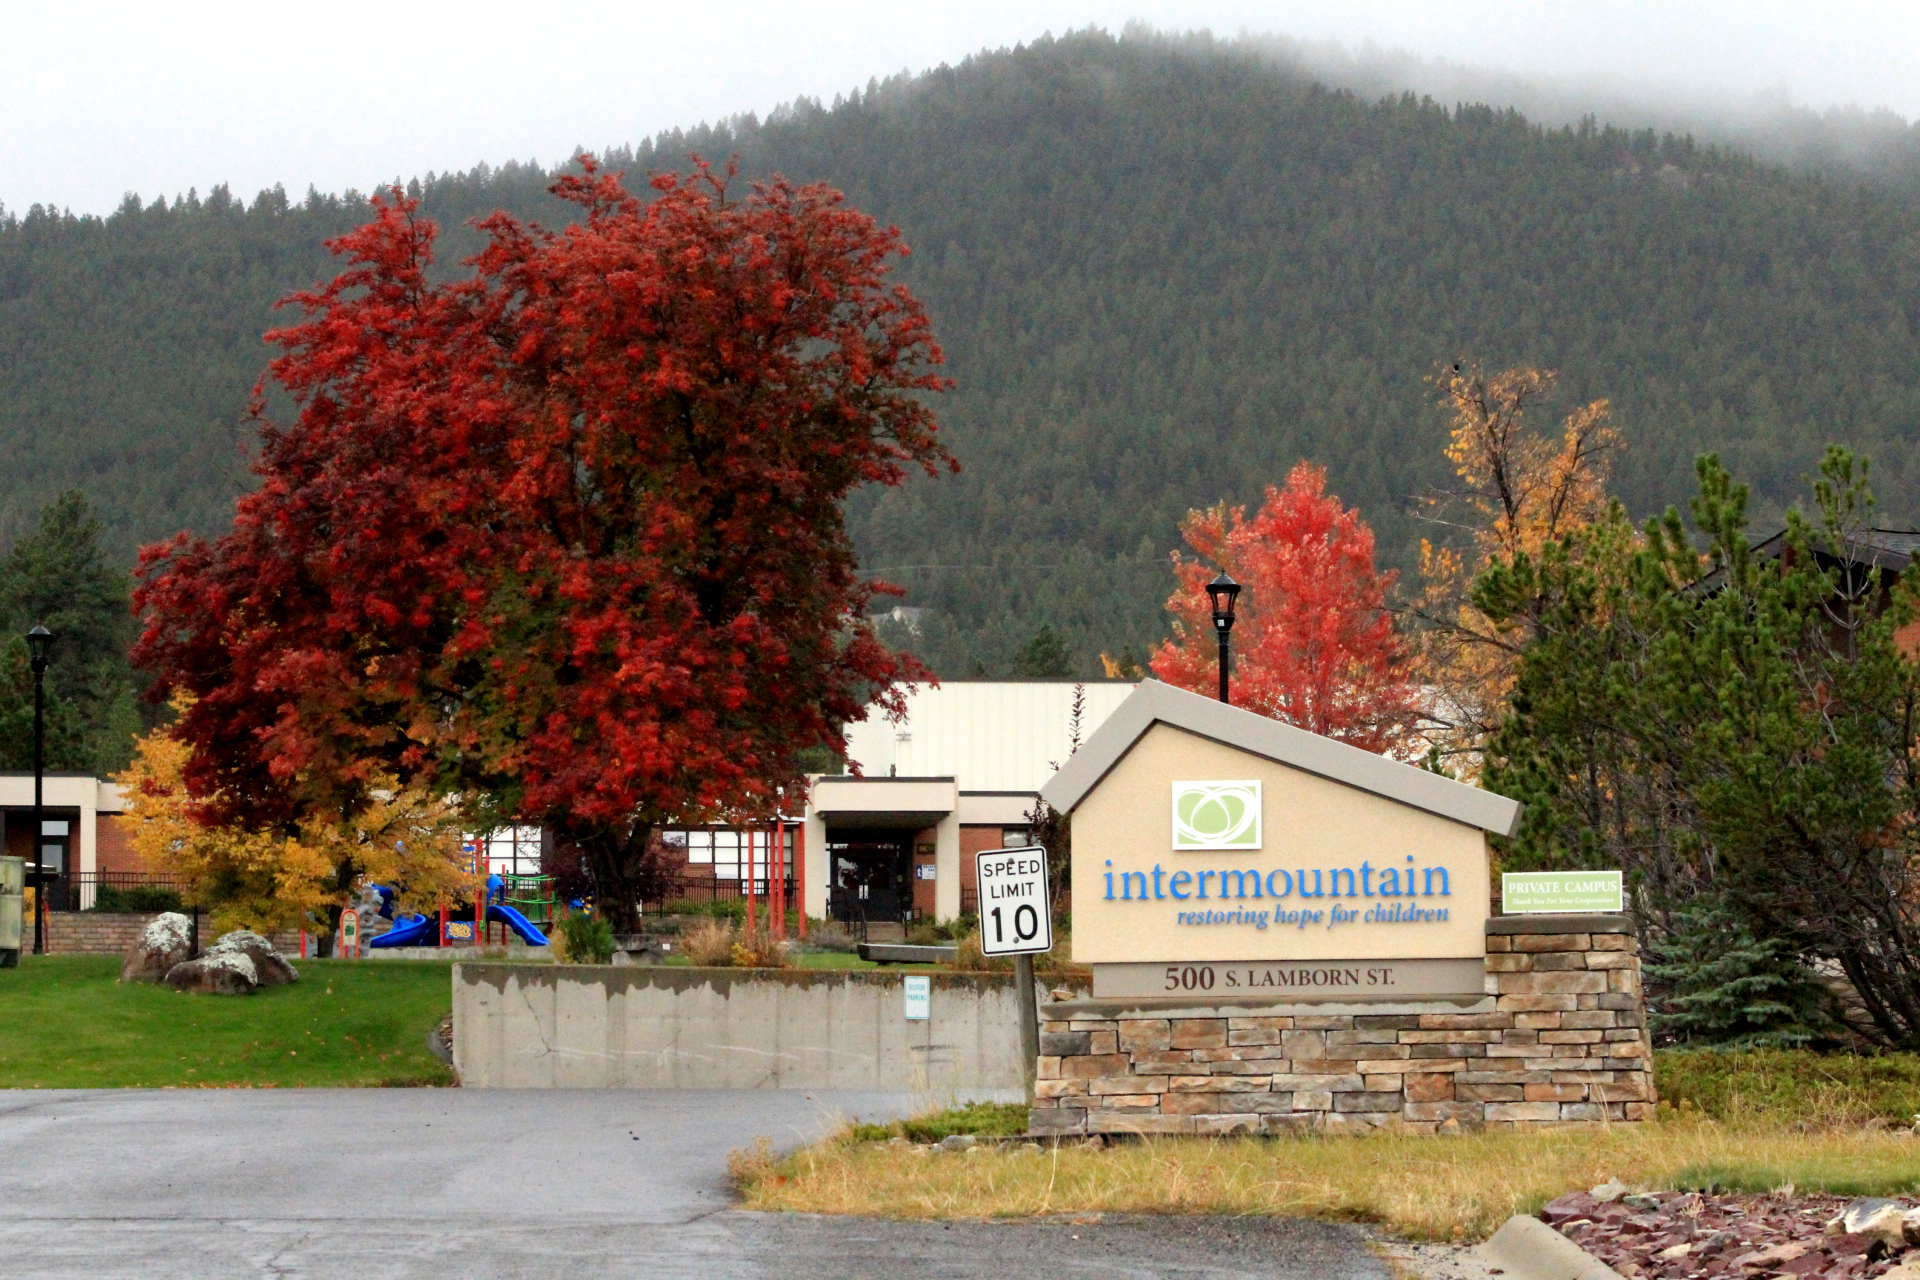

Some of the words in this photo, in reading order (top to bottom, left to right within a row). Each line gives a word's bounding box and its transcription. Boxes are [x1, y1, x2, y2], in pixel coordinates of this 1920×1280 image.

[983, 860, 1040, 877] SPEED
[1103, 855, 1451, 900] intermountain
[991, 882, 1034, 899] LIMIT
[1508, 881, 1560, 893] PRIVATE
[1565, 880, 1617, 893] CAMPUS
[991, 904, 1038, 942] 10
[1177, 905, 1268, 930] restoring
[1274, 904, 1323, 929] hope
[1328, 903, 1359, 929] for
[1364, 902, 1449, 923] children
[1164, 966, 1215, 991] 500
[1225, 970, 1241, 987] S.
[1247, 968, 1359, 987] LAMBORN
[1367, 968, 1395, 985] ST.
